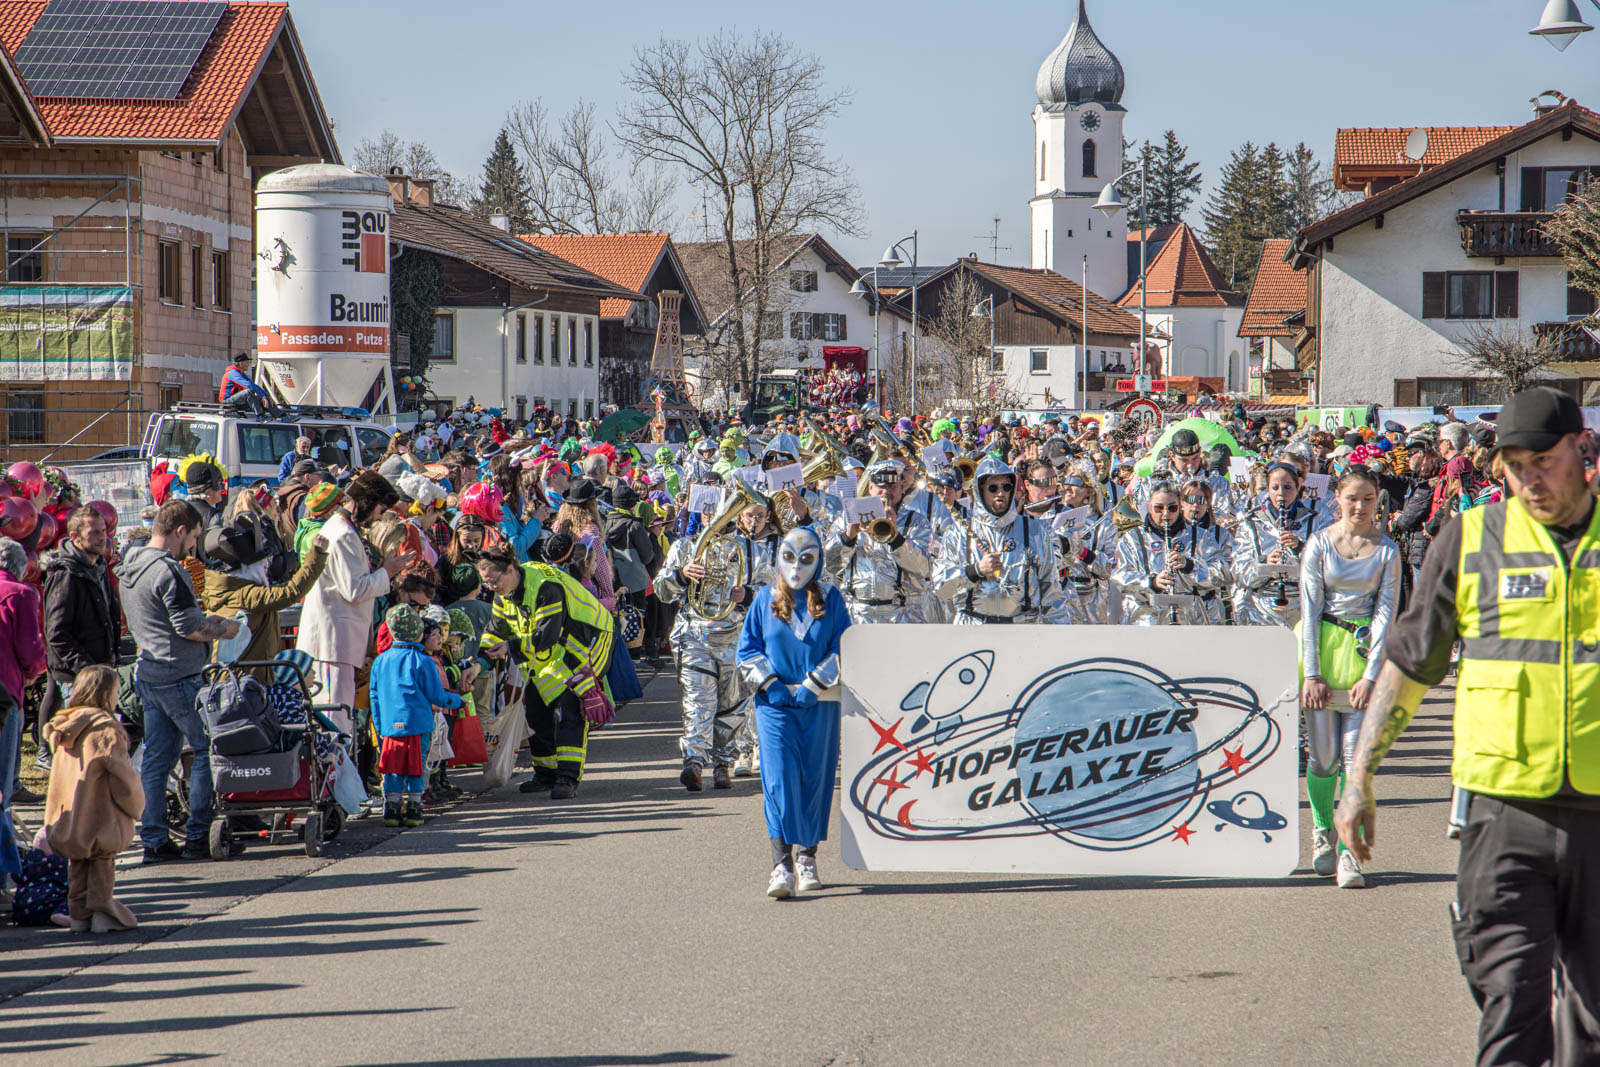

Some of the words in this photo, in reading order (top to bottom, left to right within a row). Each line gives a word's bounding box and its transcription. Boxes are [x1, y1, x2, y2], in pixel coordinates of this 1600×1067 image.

[281, 332, 344, 345] Fassaden
[356, 333, 383, 346] Putze
[932, 707, 1199, 789] HOPFERAUER
[230, 767, 272, 778] AREBOS
[967, 746, 1174, 811] GALAXIE
